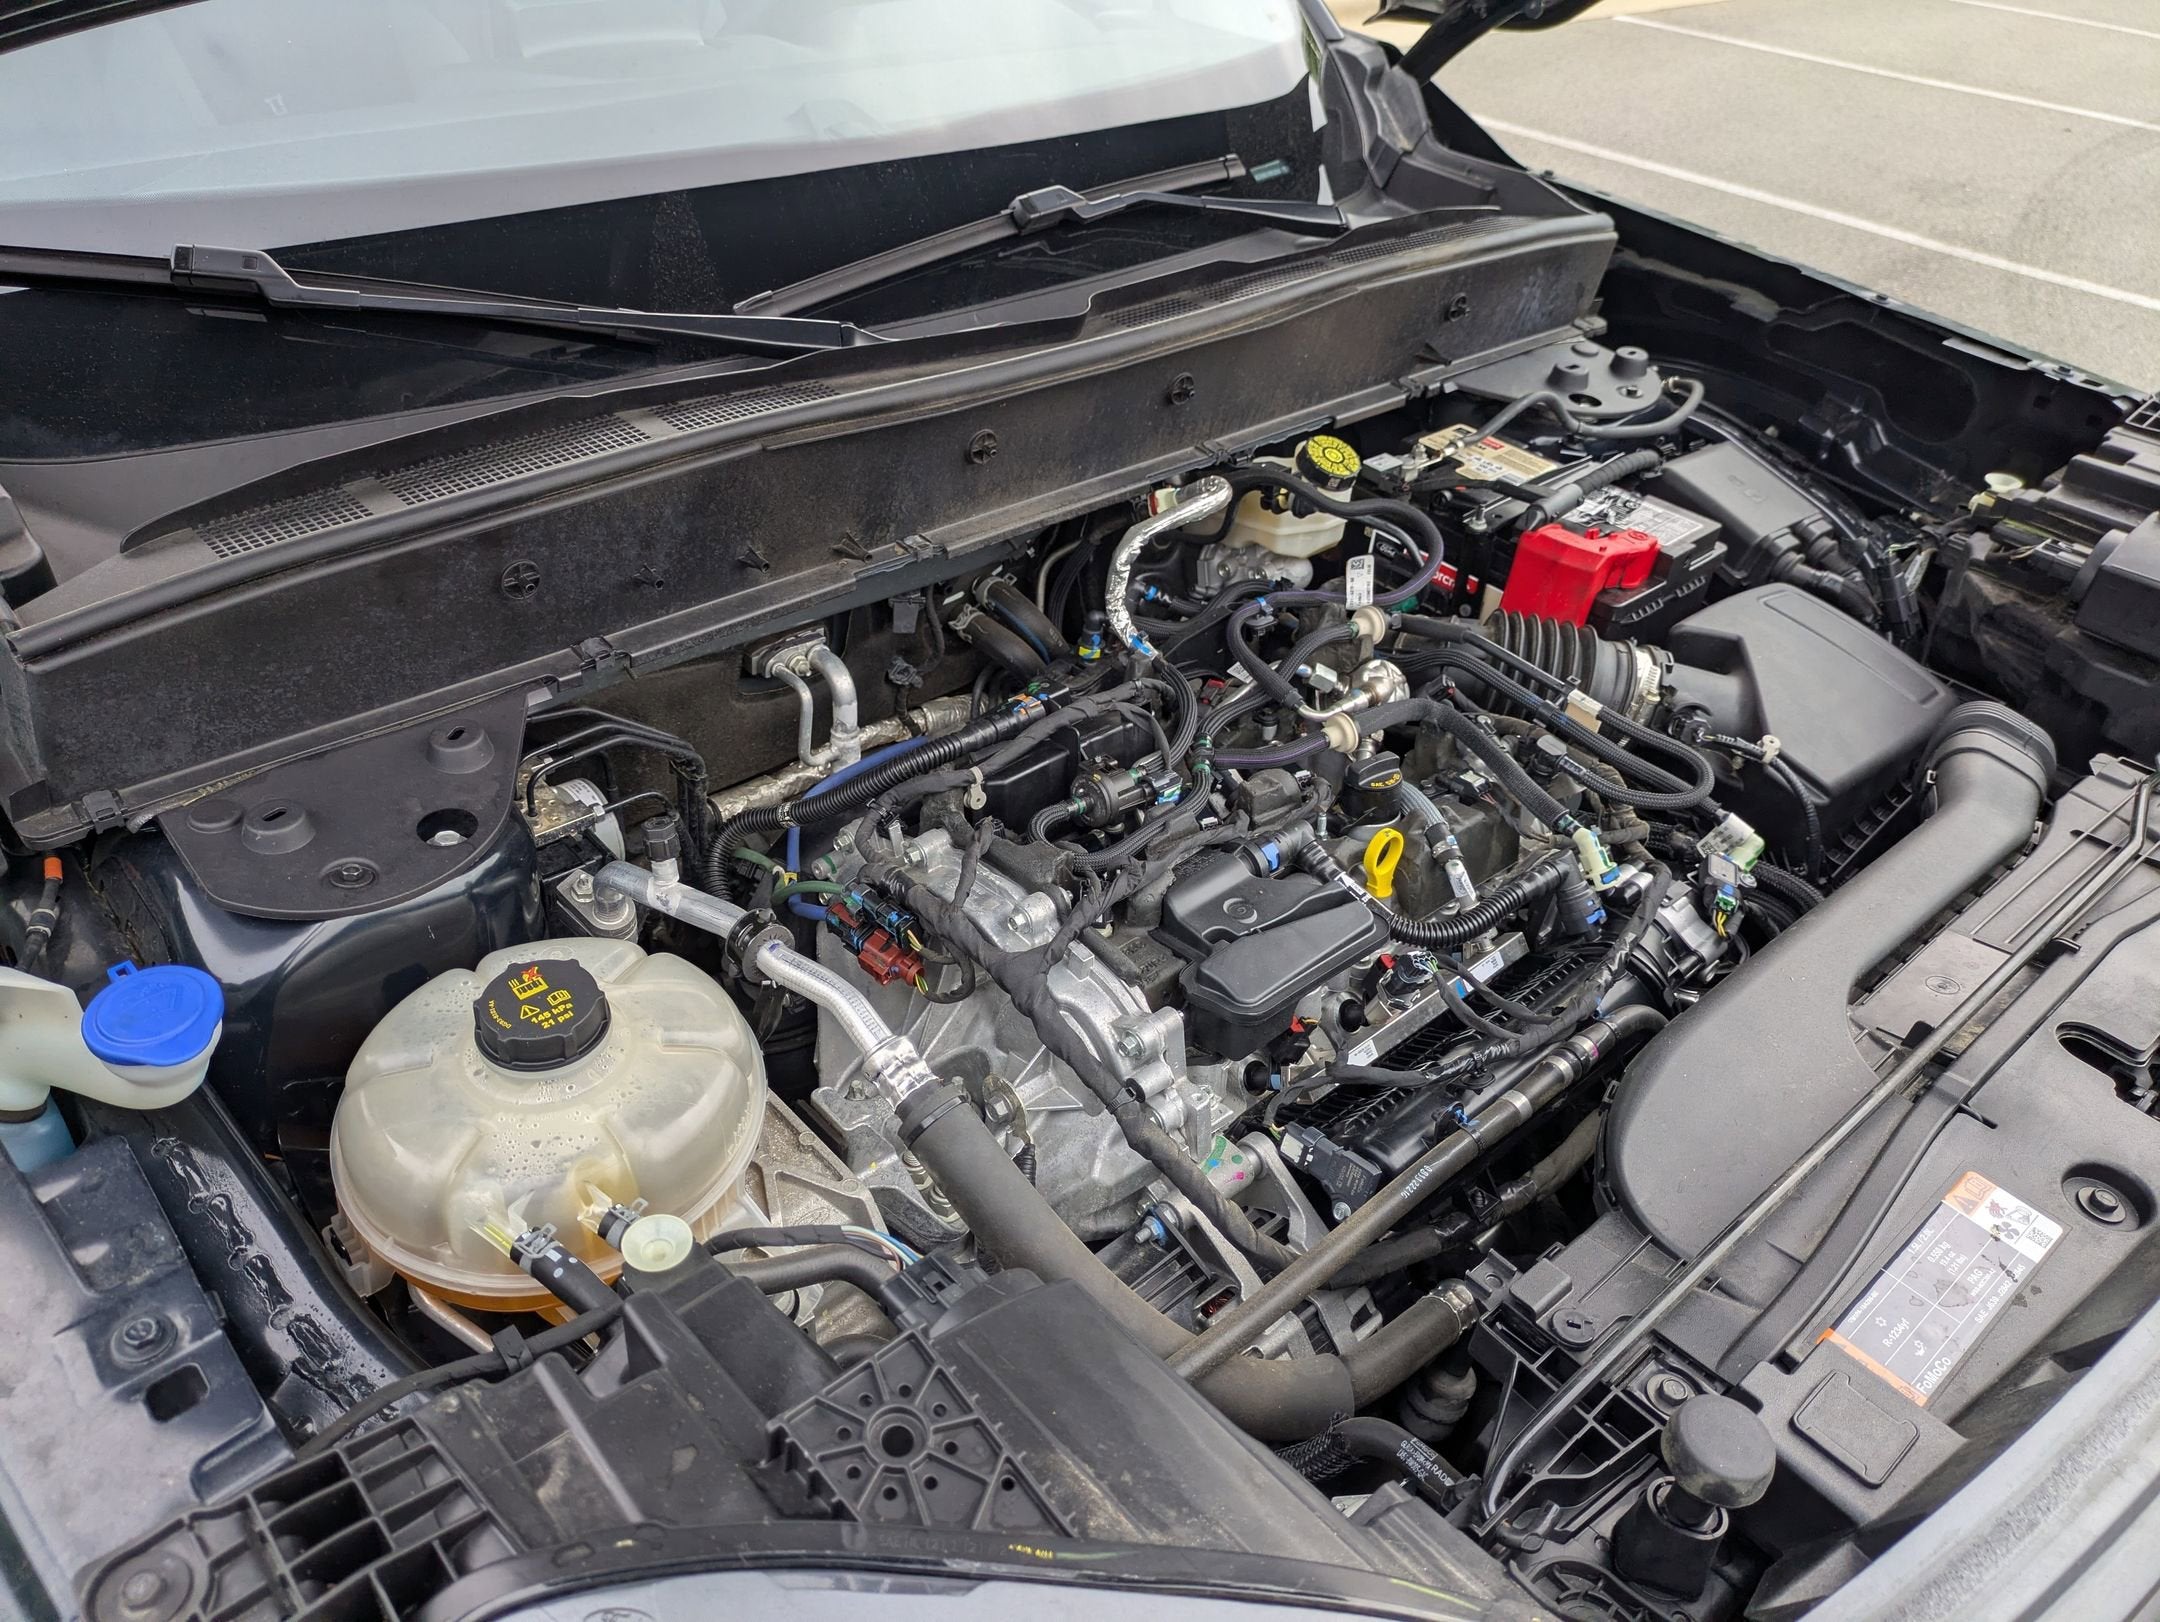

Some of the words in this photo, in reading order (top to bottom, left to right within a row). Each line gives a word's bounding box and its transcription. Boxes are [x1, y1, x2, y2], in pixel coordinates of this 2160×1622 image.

[531, 1011, 552, 1024] 145
[552, 1003, 574, 1014] kPa
[541, 1018, 556, 1030] 21
[557, 1010, 574, 1023] psi
[1967, 1268, 1982, 1284] PAG
[1974, 1307, 1989, 1323] SAE
[1883, 1317, 1910, 1348] R-1234yf
[1916, 1355, 1952, 1394] FoMoCo
[1431, 1464, 1448, 1482] RAD
